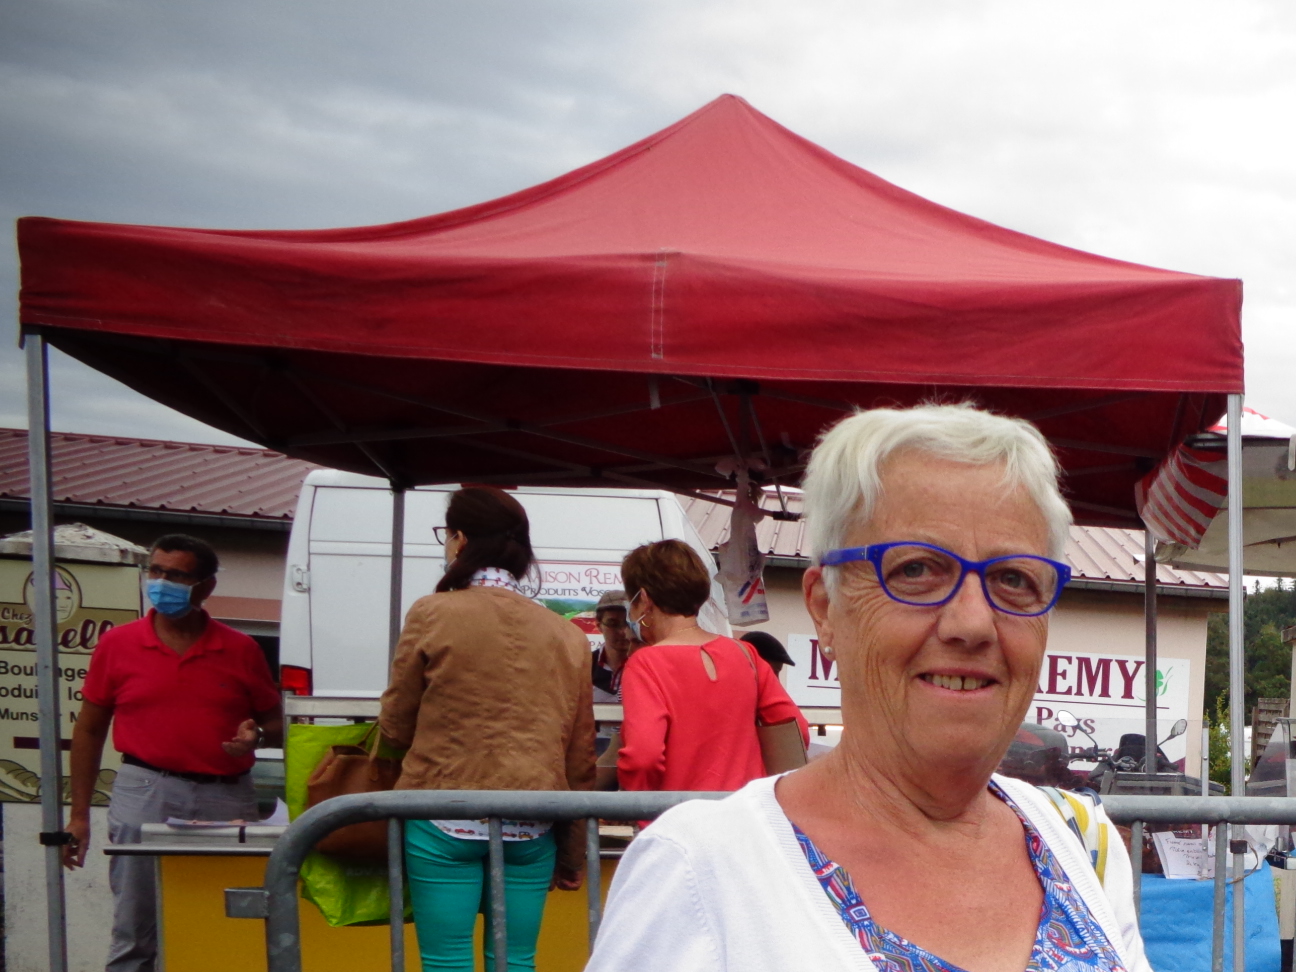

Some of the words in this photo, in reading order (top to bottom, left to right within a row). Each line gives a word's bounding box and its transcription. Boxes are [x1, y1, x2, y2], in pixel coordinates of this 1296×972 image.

[581, 586, 608, 598] VOS
[1, 607, 32, 625] Chez
[1036, 654, 1145, 700] EMY
